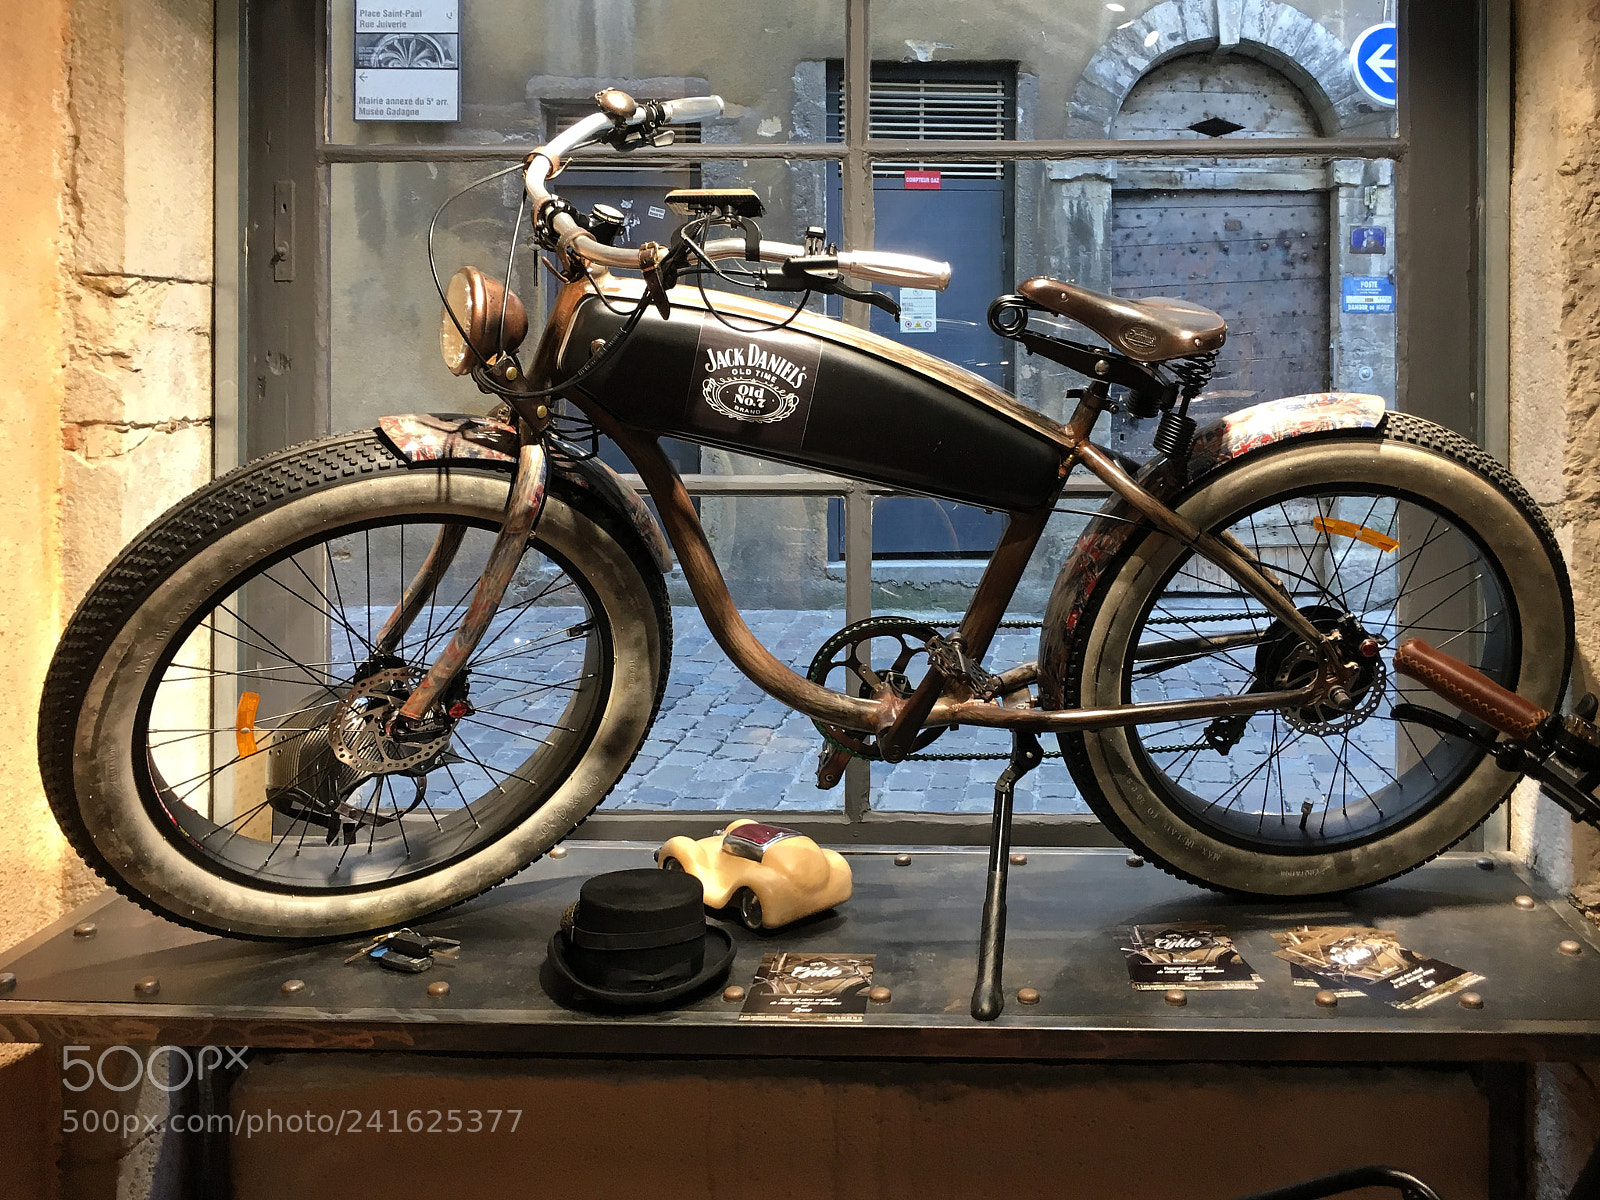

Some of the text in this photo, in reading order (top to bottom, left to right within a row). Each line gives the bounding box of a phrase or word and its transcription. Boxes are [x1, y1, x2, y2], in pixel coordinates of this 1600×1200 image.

[359, 9, 422, 18] Place Saint-Paul
[359, 20, 375, 28] Rue
[358, 96, 384, 106] Mairie
[385, 98, 413, 106] annexe
[414, 97, 425, 106] du
[435, 98, 449, 106] arr.
[386, 107, 420, 117] Gadagne
[1360, 280, 1378, 288] POSTE
[704, 347, 746, 373] JACK
[731, 368, 778, 383] OLD TIME
[737, 384, 765, 399] Old
[733, 393, 767, 409] No.7
[733, 405, 761, 415] BRAND
